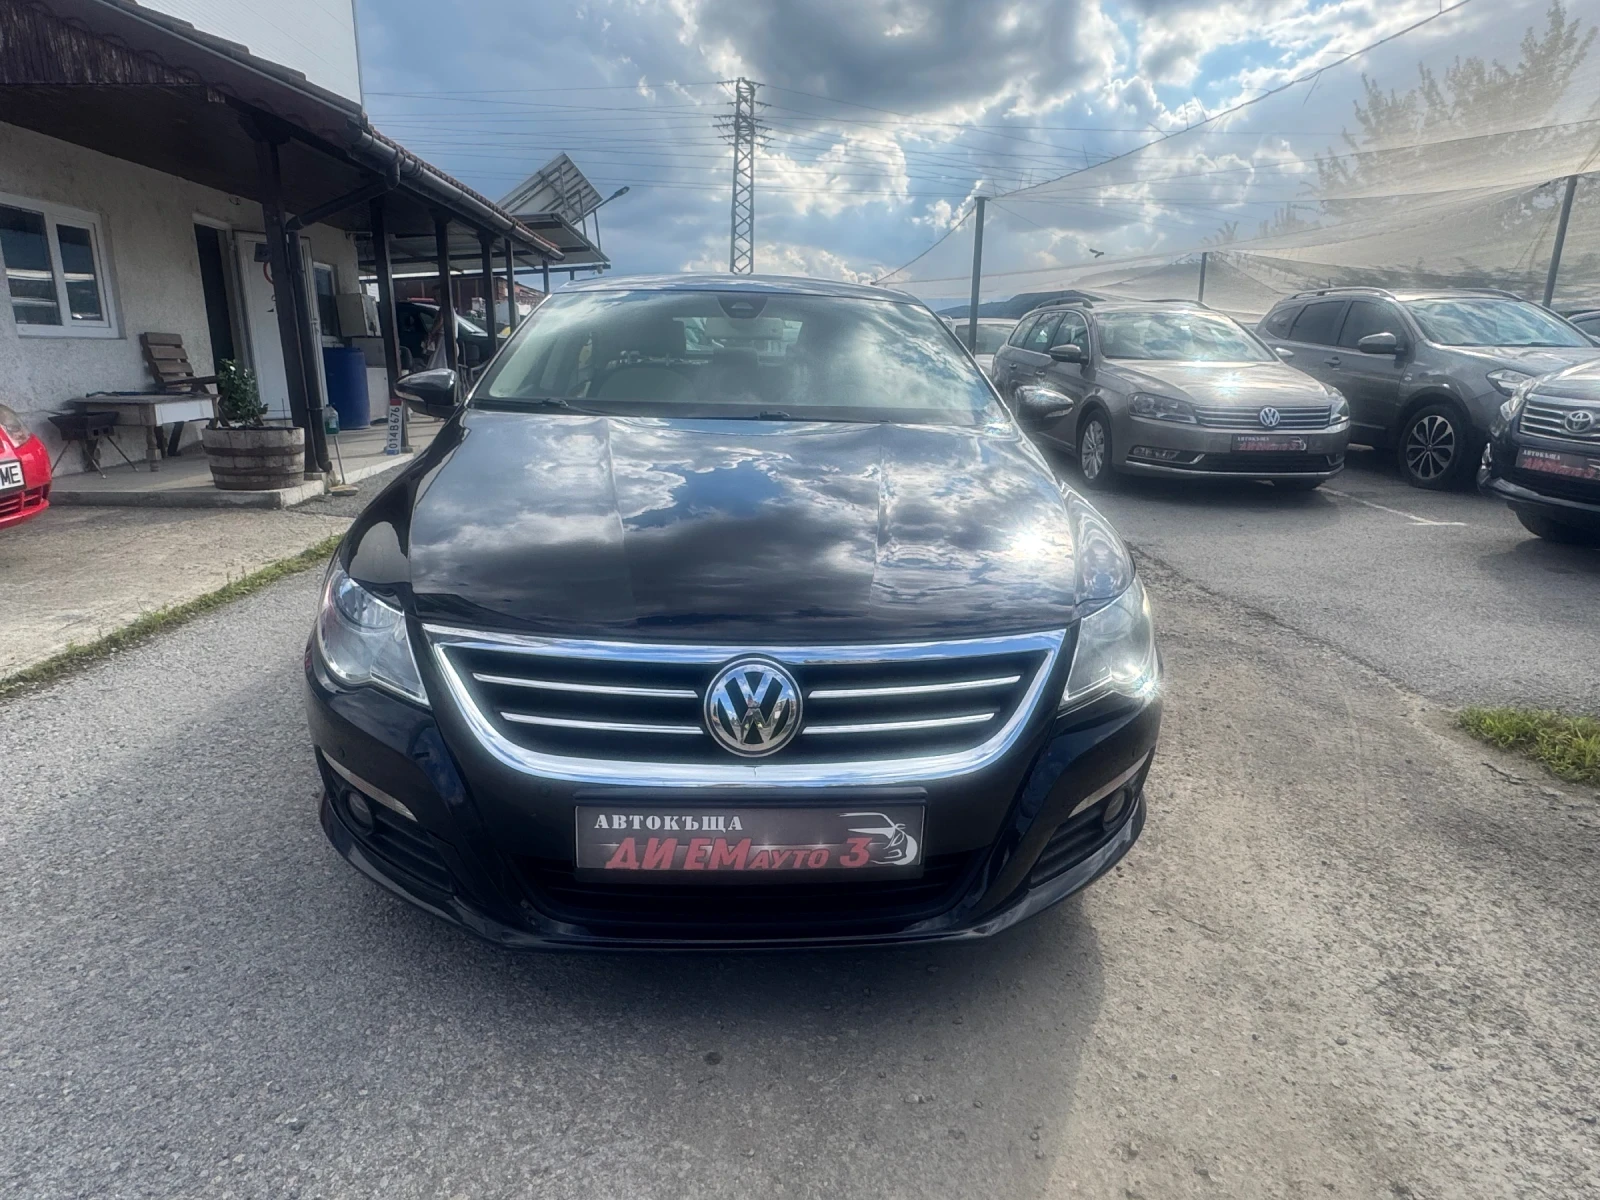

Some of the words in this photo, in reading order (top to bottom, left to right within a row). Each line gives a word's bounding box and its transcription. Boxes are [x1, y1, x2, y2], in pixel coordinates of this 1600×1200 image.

[594, 814, 743, 833] АВТОКЪЩА
[604, 837, 678, 870] ДИ
[838, 837, 873, 867] 3
